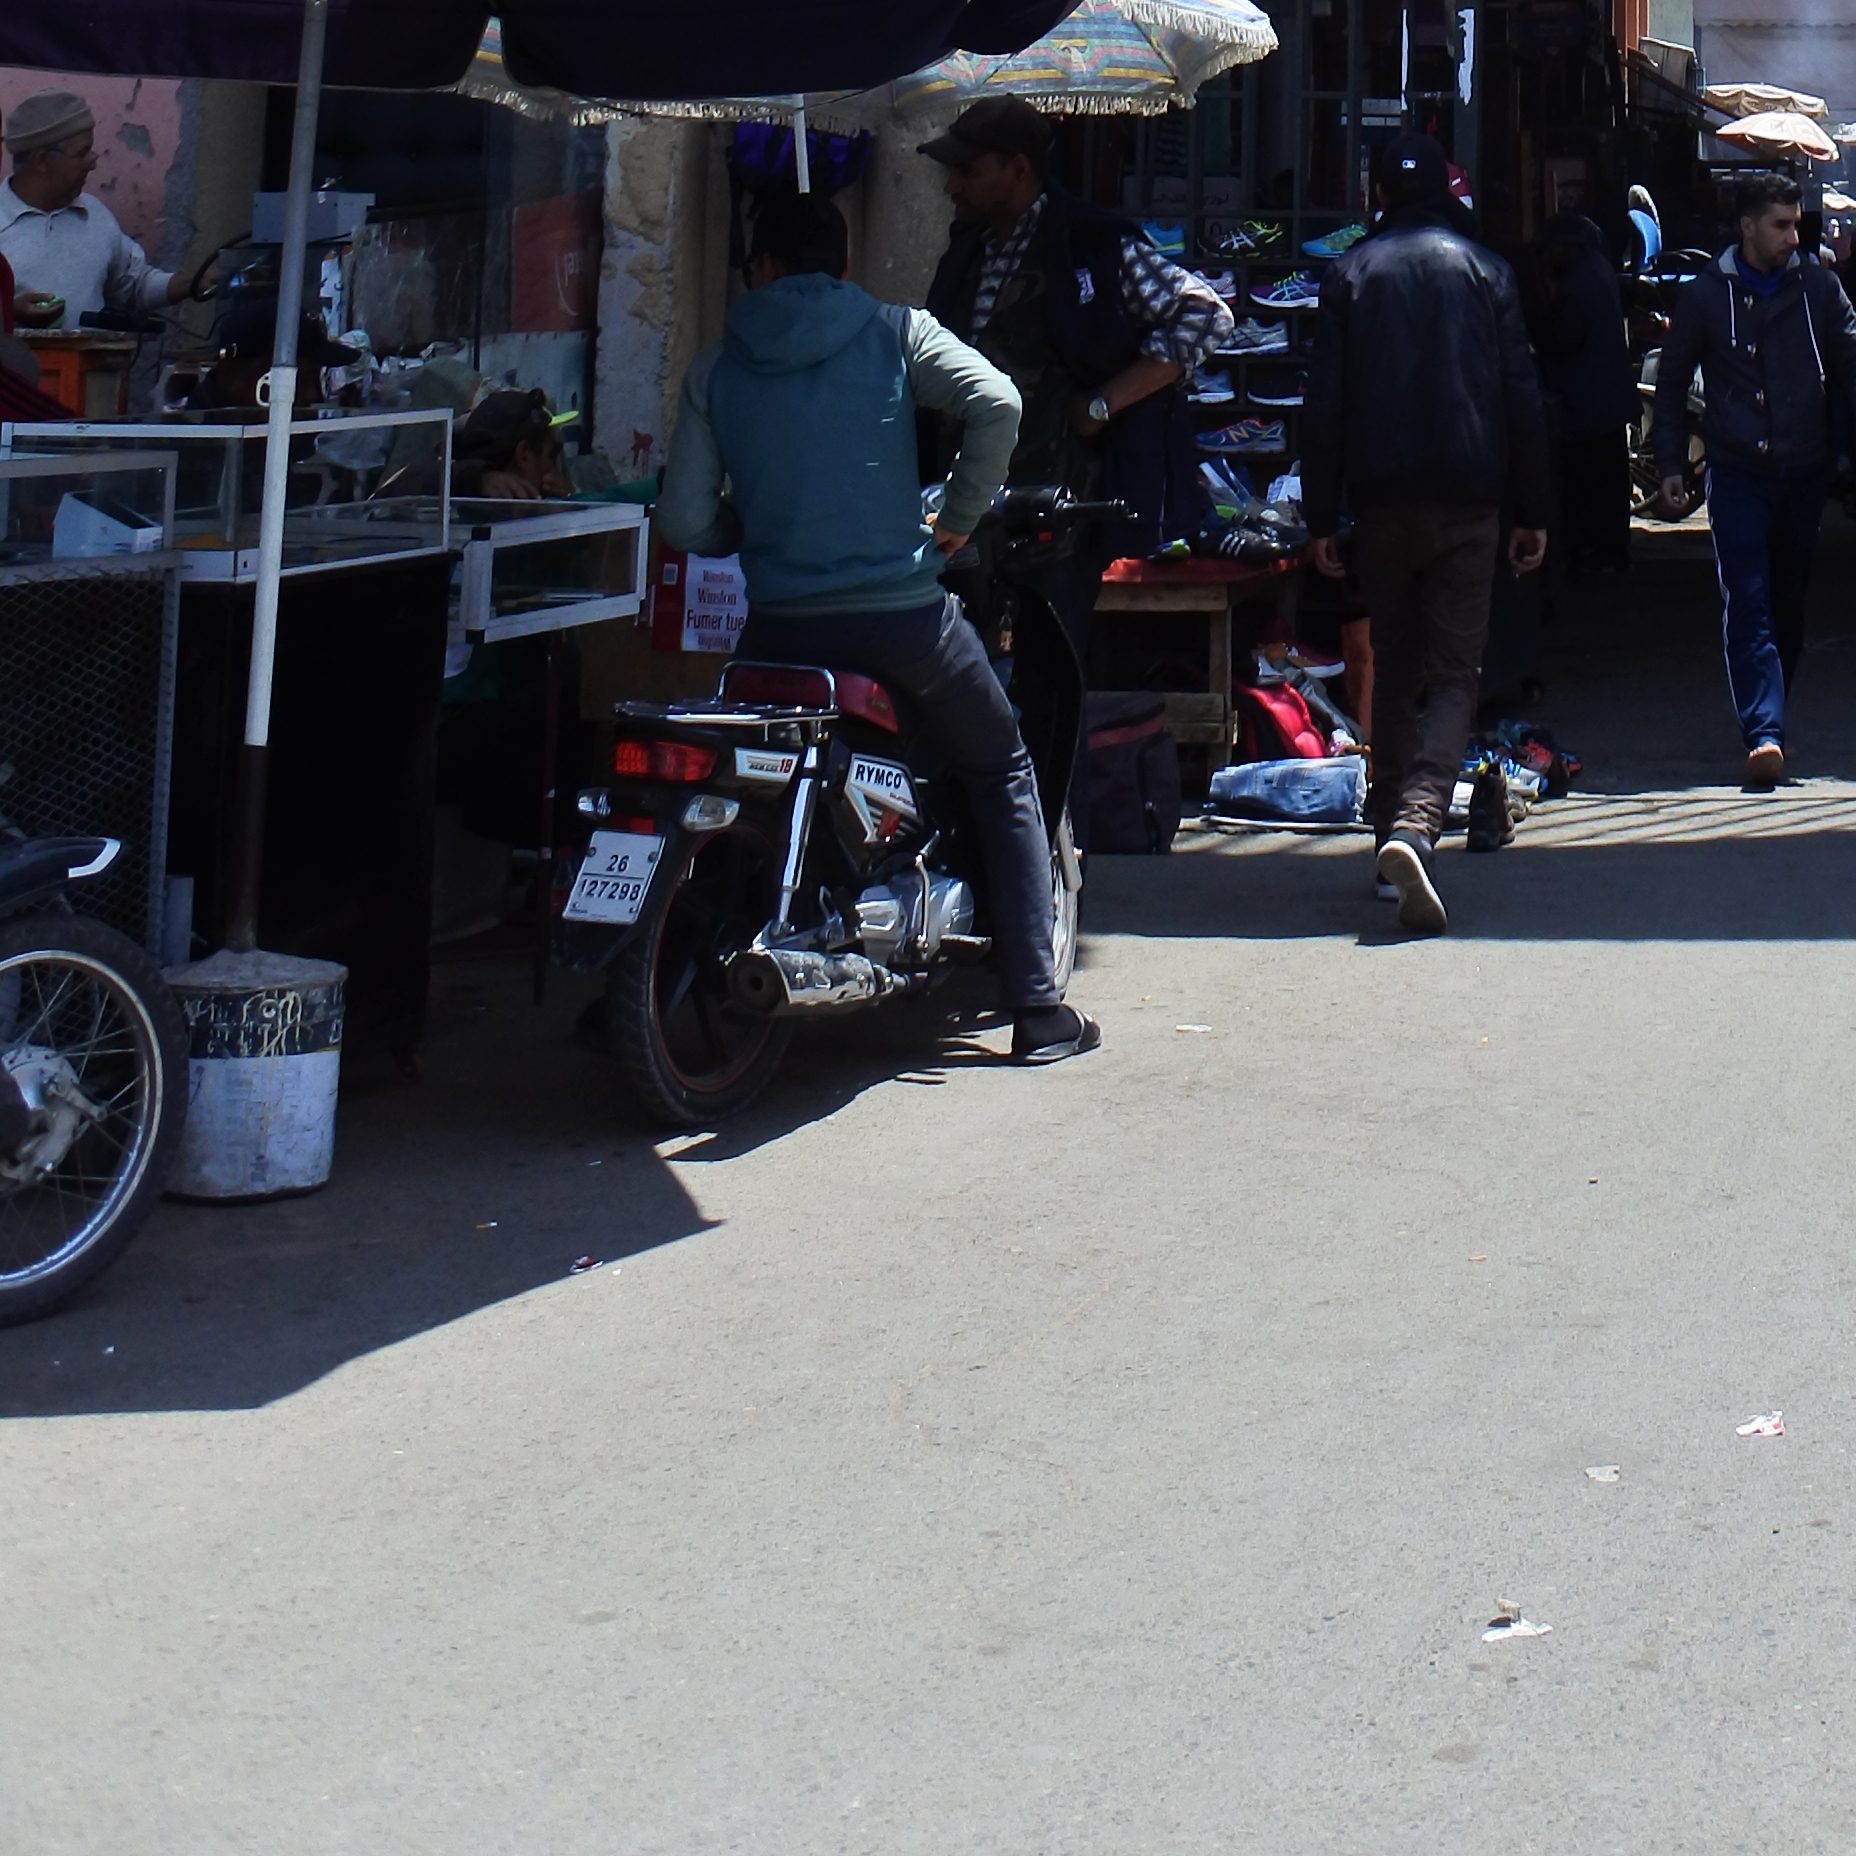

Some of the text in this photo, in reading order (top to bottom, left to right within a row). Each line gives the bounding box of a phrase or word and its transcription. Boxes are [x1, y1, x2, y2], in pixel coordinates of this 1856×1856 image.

[698, 587, 737, 605] Winston
[686, 609, 745, 631] Fumer tue
[855, 763, 902, 789] RYMCO
[606, 854, 630, 872] 26
[580, 879, 641, 901] 127298
